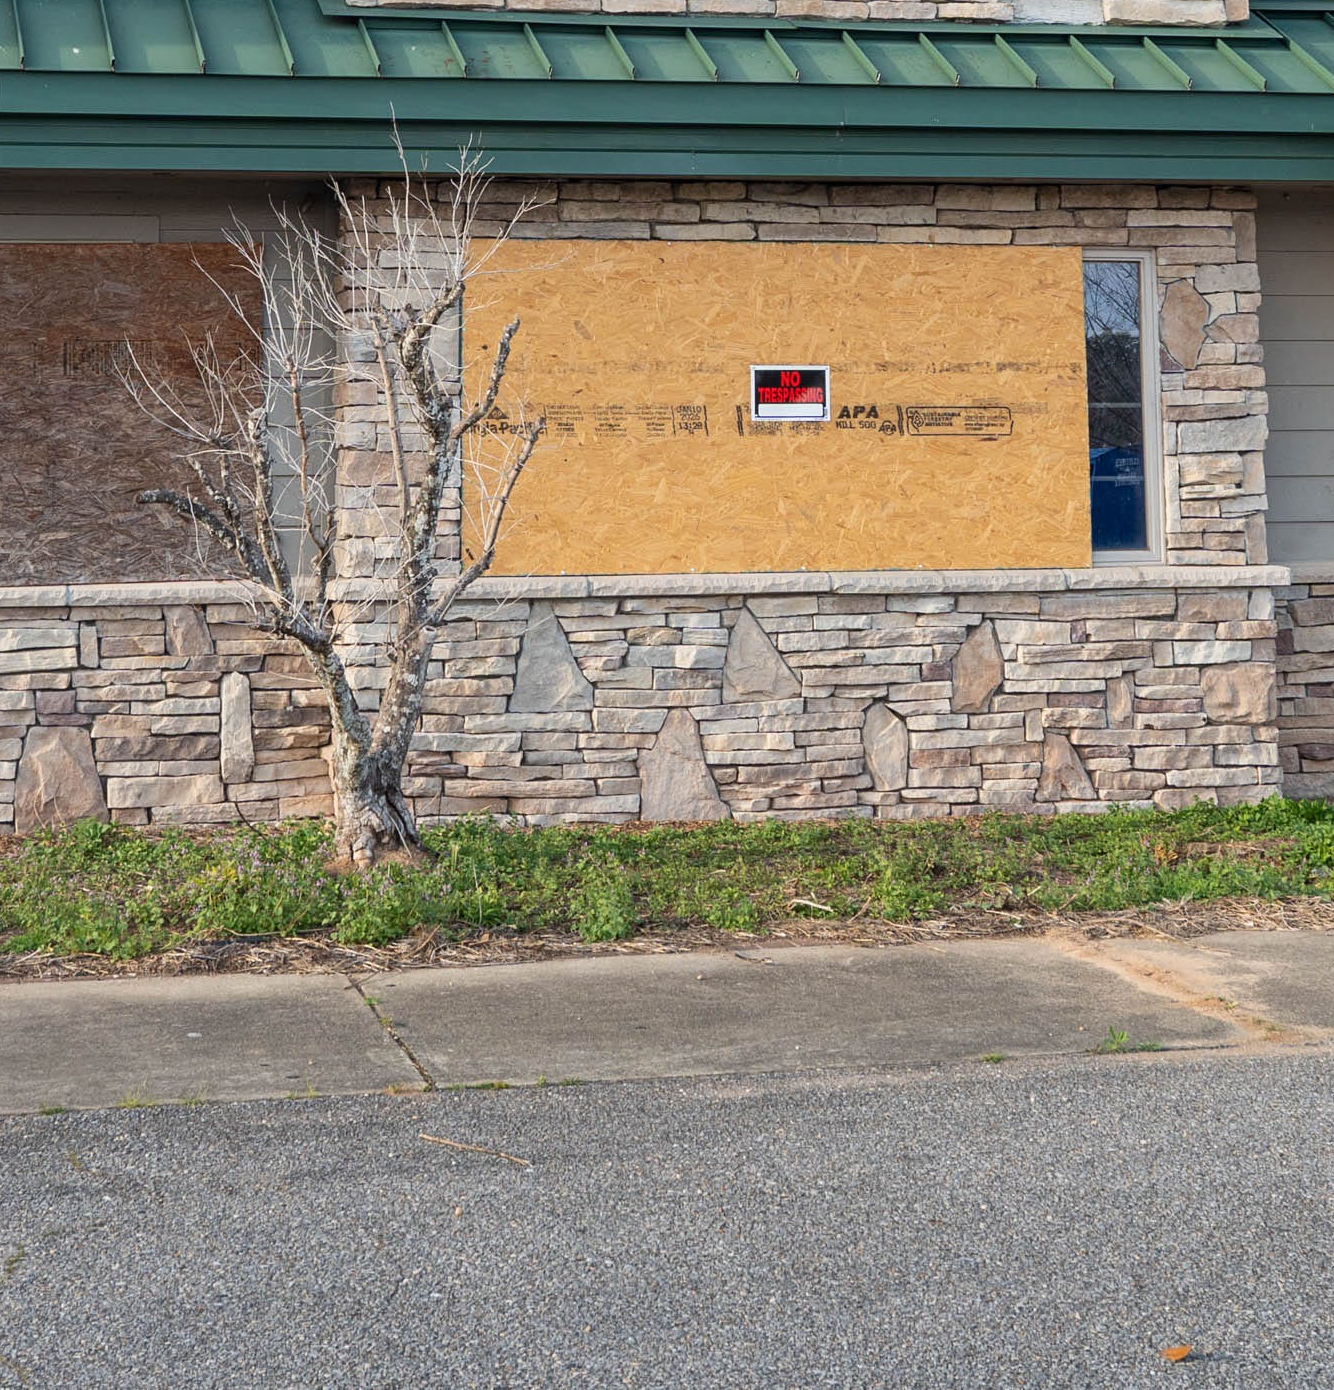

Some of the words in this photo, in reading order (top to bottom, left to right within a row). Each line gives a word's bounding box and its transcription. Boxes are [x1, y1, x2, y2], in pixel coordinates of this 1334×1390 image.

[780, 371, 801, 387] NO
[758, 387, 824, 403] TRESPASSING
[838, 405, 879, 419] APA
